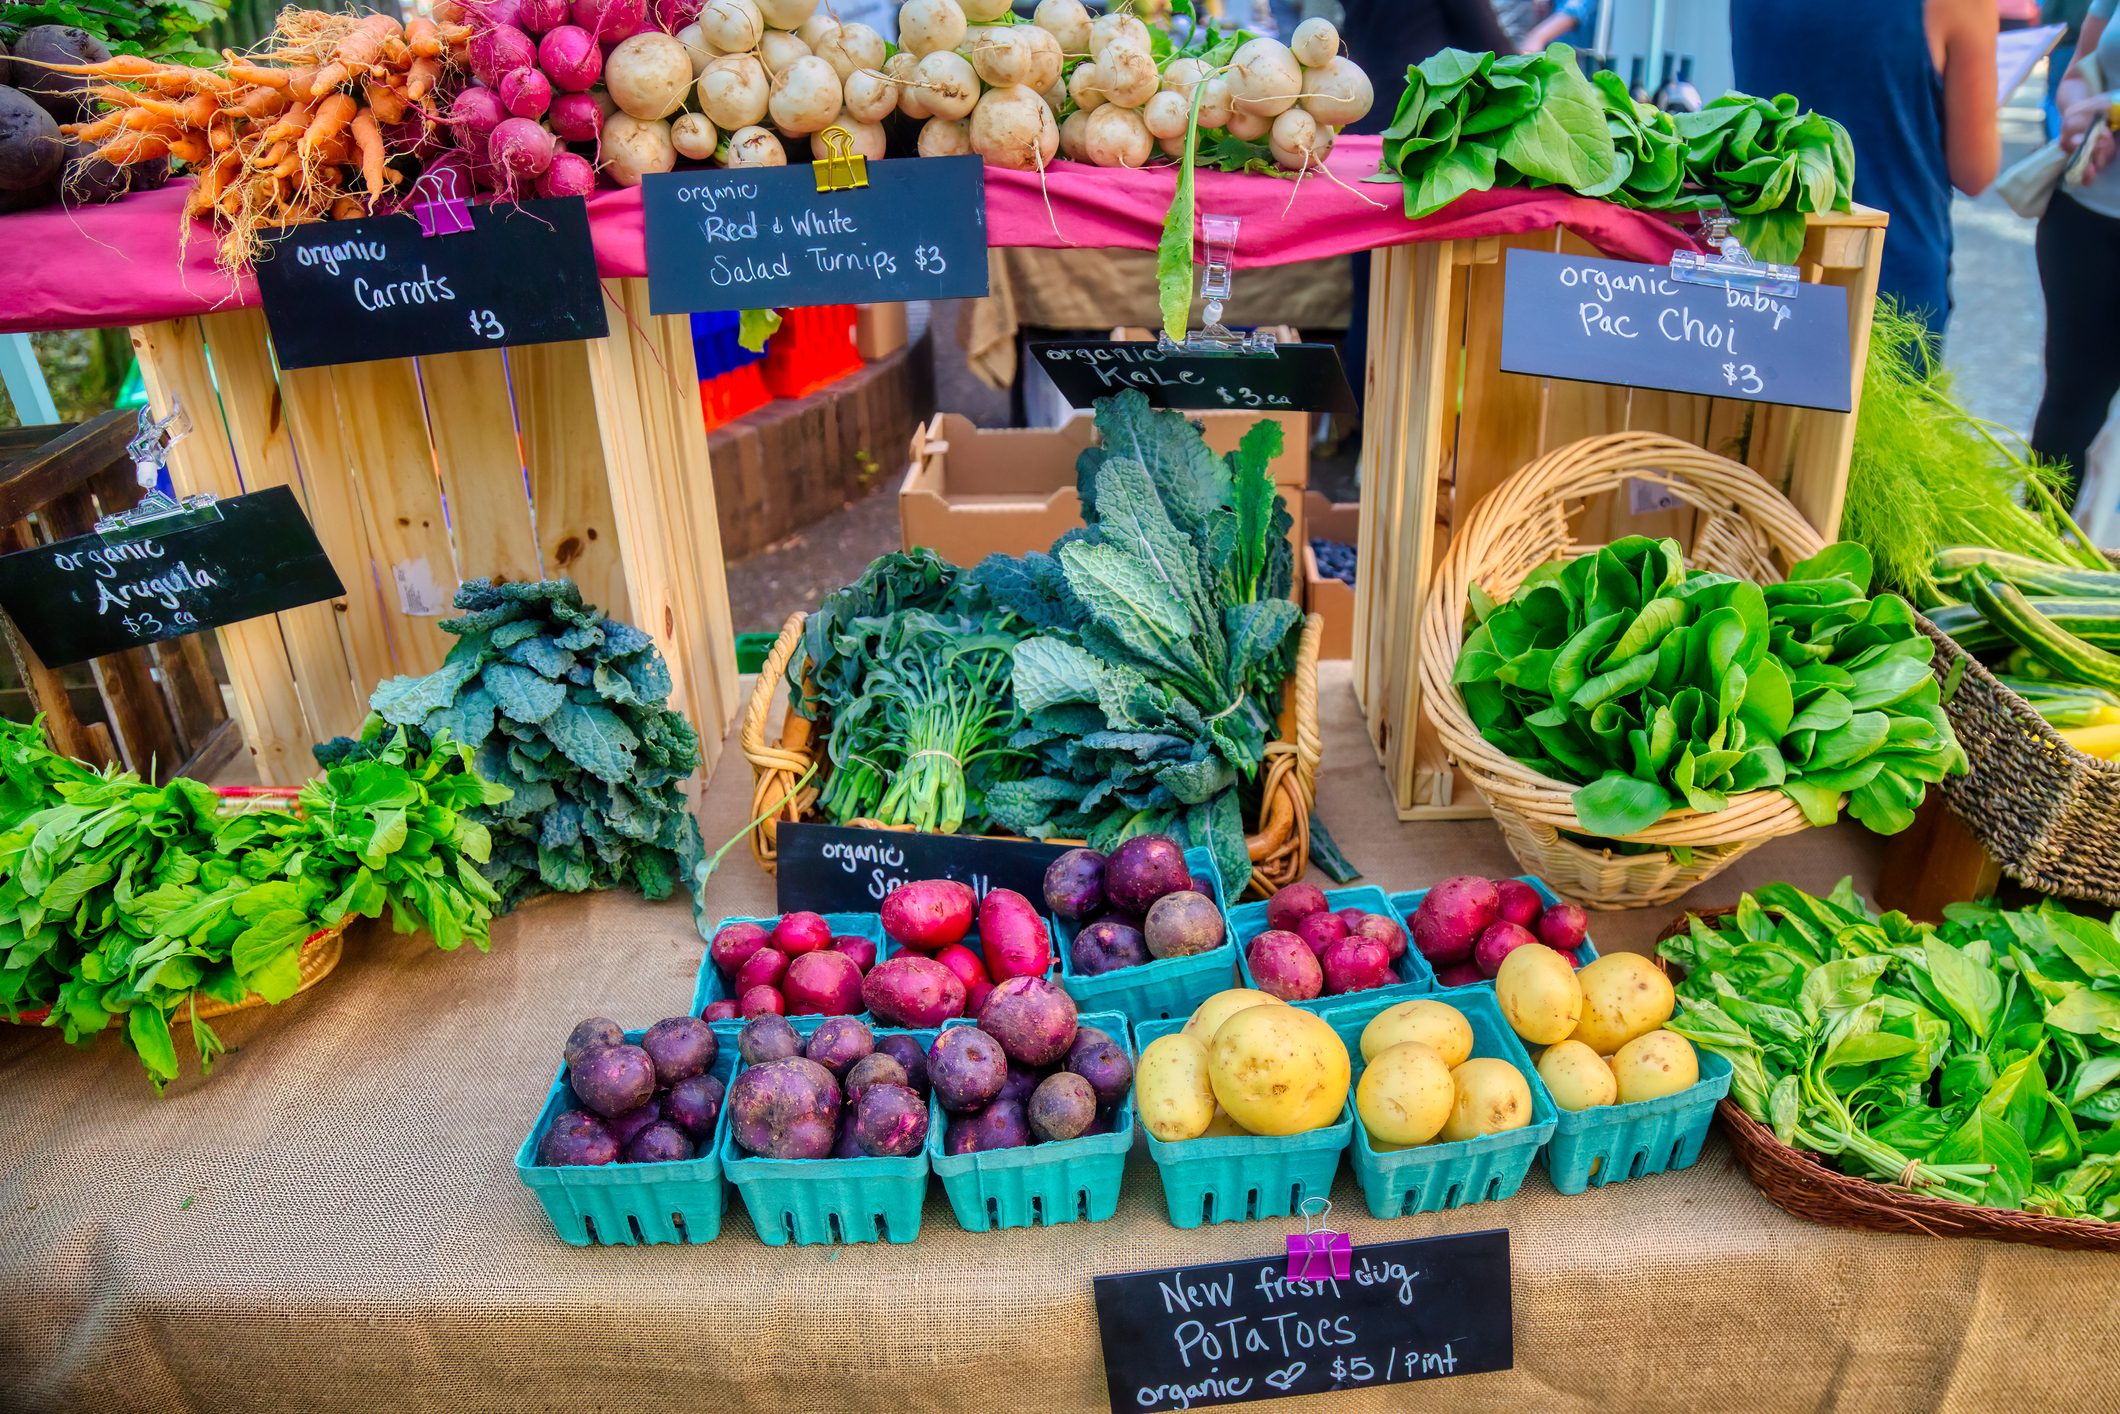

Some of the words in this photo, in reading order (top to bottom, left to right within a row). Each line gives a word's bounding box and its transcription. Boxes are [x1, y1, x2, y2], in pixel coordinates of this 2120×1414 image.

[677, 179, 758, 212] organic
[704, 210, 758, 243] Red
[790, 207, 858, 237] White
[296, 228, 386, 277] organic
[709, 252, 792, 287] Salad
[804, 241, 898, 280] Turnips
[914, 244, 947, 275] $3
[353, 263, 456, 312] Carrots
[1559, 265, 1680, 303] organic
[1724, 279, 1789, 331] baby
[468, 309, 506, 340] $3
[1579, 302, 1640, 338] Pac
[1657, 306, 1738, 356] Choi
[1045, 346, 1168, 366] organic
[1721, 361, 1765, 395] $3
[53, 538, 166, 579] organic
[95, 559, 220, 616] Arugula
[121, 611, 164, 638] $3
[172, 611, 200, 626] ea
[821, 838, 905, 874] organic
[1354, 1257, 1421, 1307] dug
[1135, 1365, 1255, 1411] organic
[1329, 1354, 1375, 1381] $5
